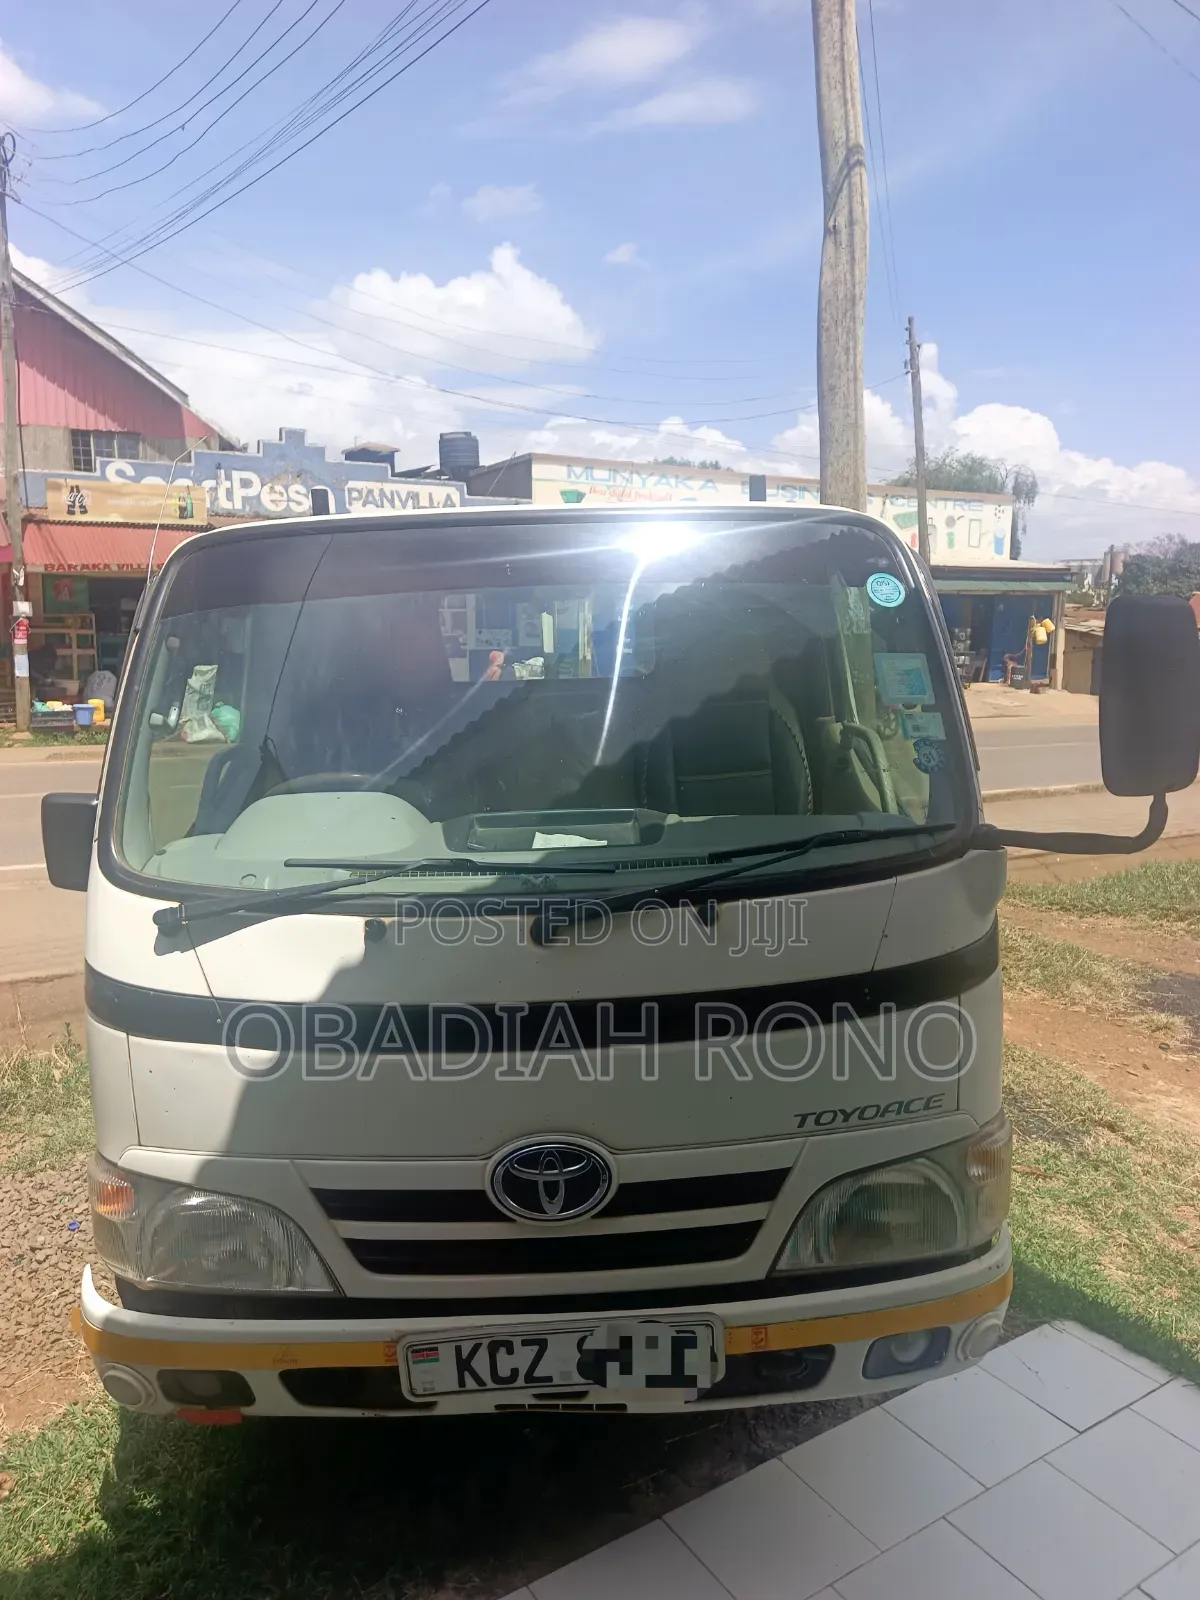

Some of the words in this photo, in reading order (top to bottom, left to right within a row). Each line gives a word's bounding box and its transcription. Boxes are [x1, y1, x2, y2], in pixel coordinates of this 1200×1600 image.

[566, 464, 720, 493] MUNYAKA
[347, 486, 457, 510] PANVILLA
[43, 562, 112, 572] BARAKA
[794, 1092, 946, 1129] TOYOACE
[454, 1337, 554, 1389] KCZ
